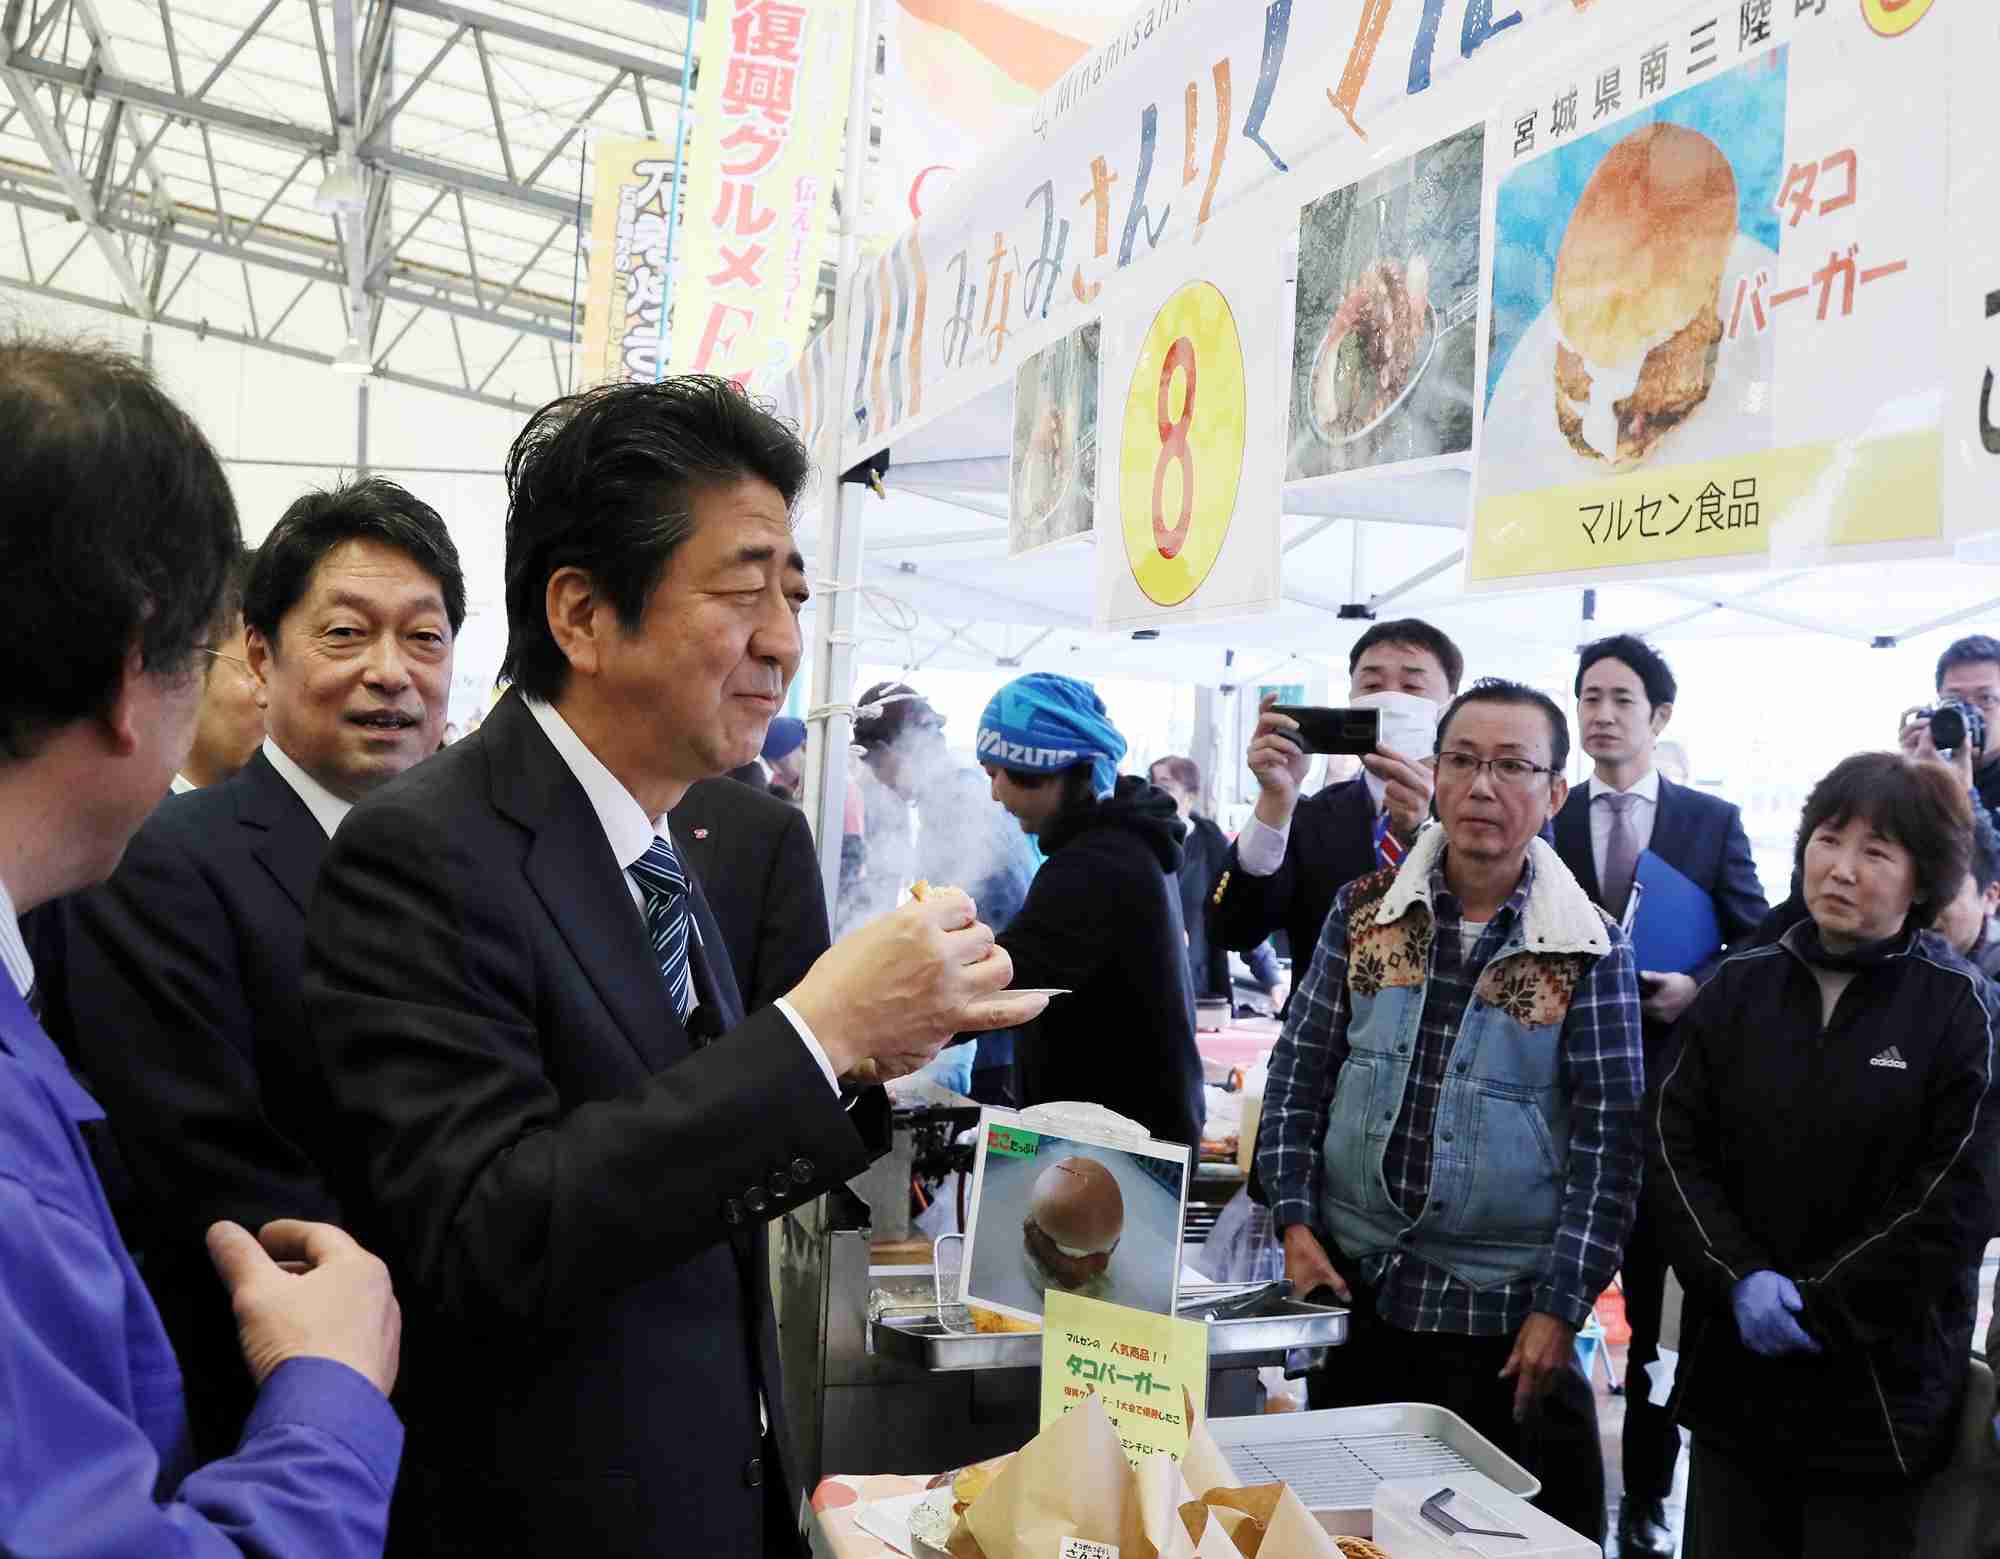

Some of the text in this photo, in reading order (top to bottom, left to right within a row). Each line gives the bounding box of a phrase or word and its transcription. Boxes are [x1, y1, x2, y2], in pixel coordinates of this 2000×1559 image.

[1055, 0, 1192, 118] Minamisan
[1776, 148, 1857, 227] タコ
[1728, 243, 1908, 339] バーガー
[1152, 336, 1196, 560] 8
[1579, 477, 1760, 546] マルセン食品
[1870, 1058, 1907, 1069] adidas
[1066, 1354, 1171, 1395] タコバーガー
